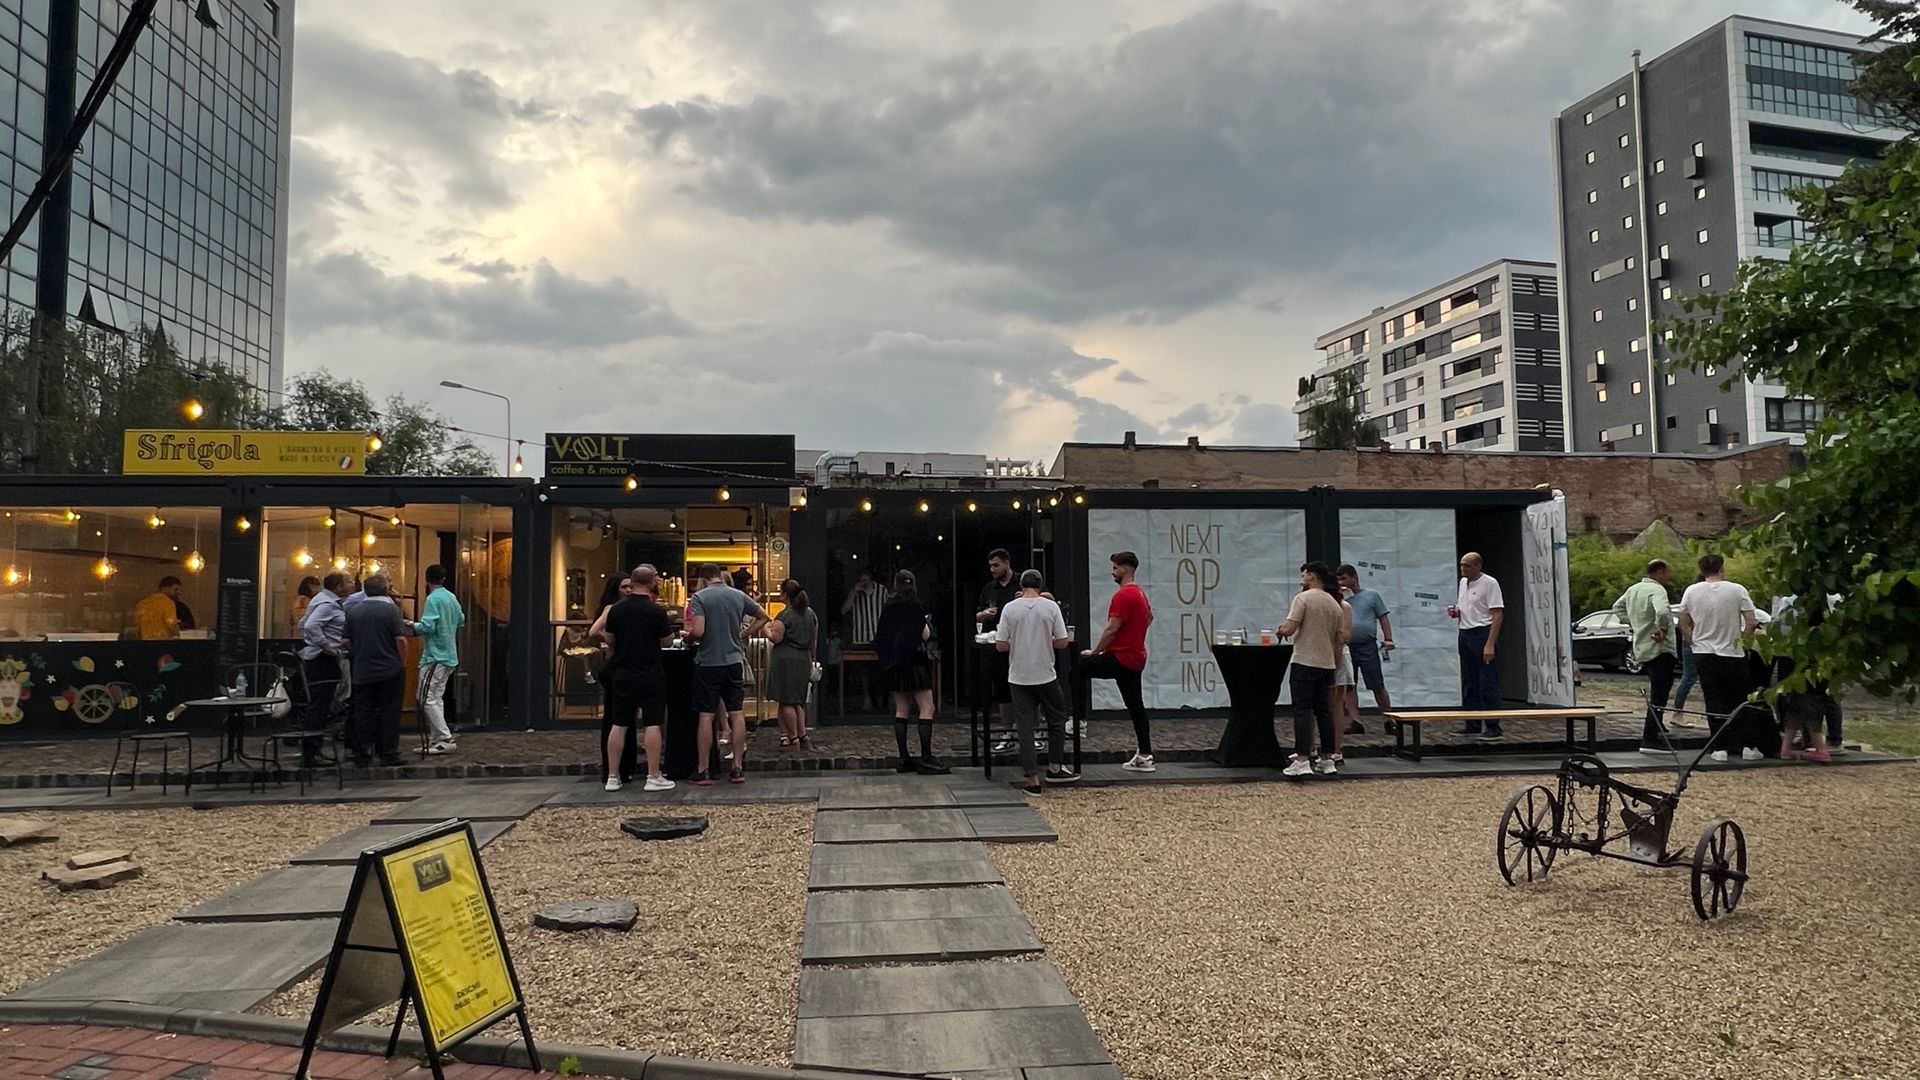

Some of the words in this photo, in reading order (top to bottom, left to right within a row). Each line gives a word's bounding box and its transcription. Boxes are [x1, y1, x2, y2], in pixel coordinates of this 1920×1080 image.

[137, 434, 261, 470] Sfrigola
[551, 436, 630, 461] VOLT
[551, 464, 584, 475] coffee
[587, 464, 596, 475] &
[599, 467, 628, 475] more
[1170, 524, 1224, 554] NEXT
[1176, 558, 1221, 605] OP
[1180, 613, 1214, 653] EN
[1181, 661, 1216, 692] ING
